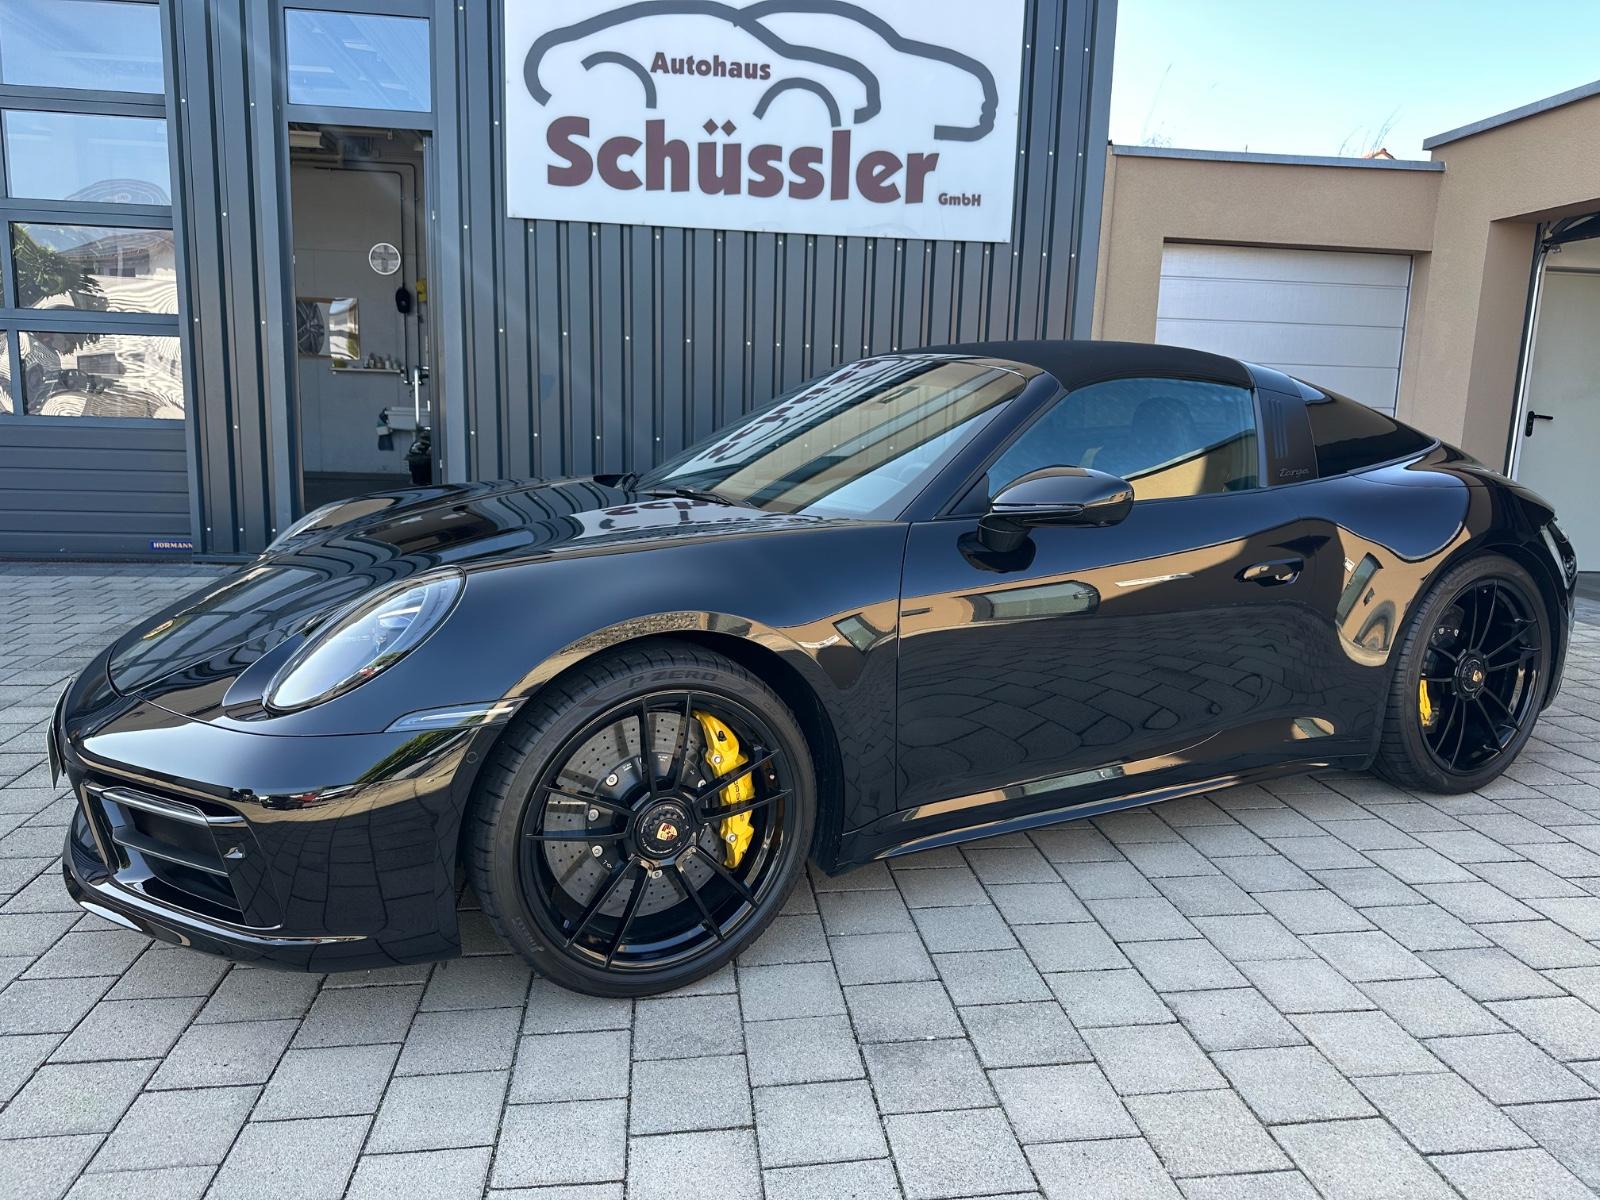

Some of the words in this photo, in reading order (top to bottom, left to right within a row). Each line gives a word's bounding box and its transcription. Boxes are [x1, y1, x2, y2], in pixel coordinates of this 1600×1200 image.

[650, 52, 771, 81] Autohaus
[546, 116, 940, 205] Schüssler
[938, 192, 982, 207] GmbH
[628, 675, 645, 689] P
[651, 669, 718, 682] ZERO
